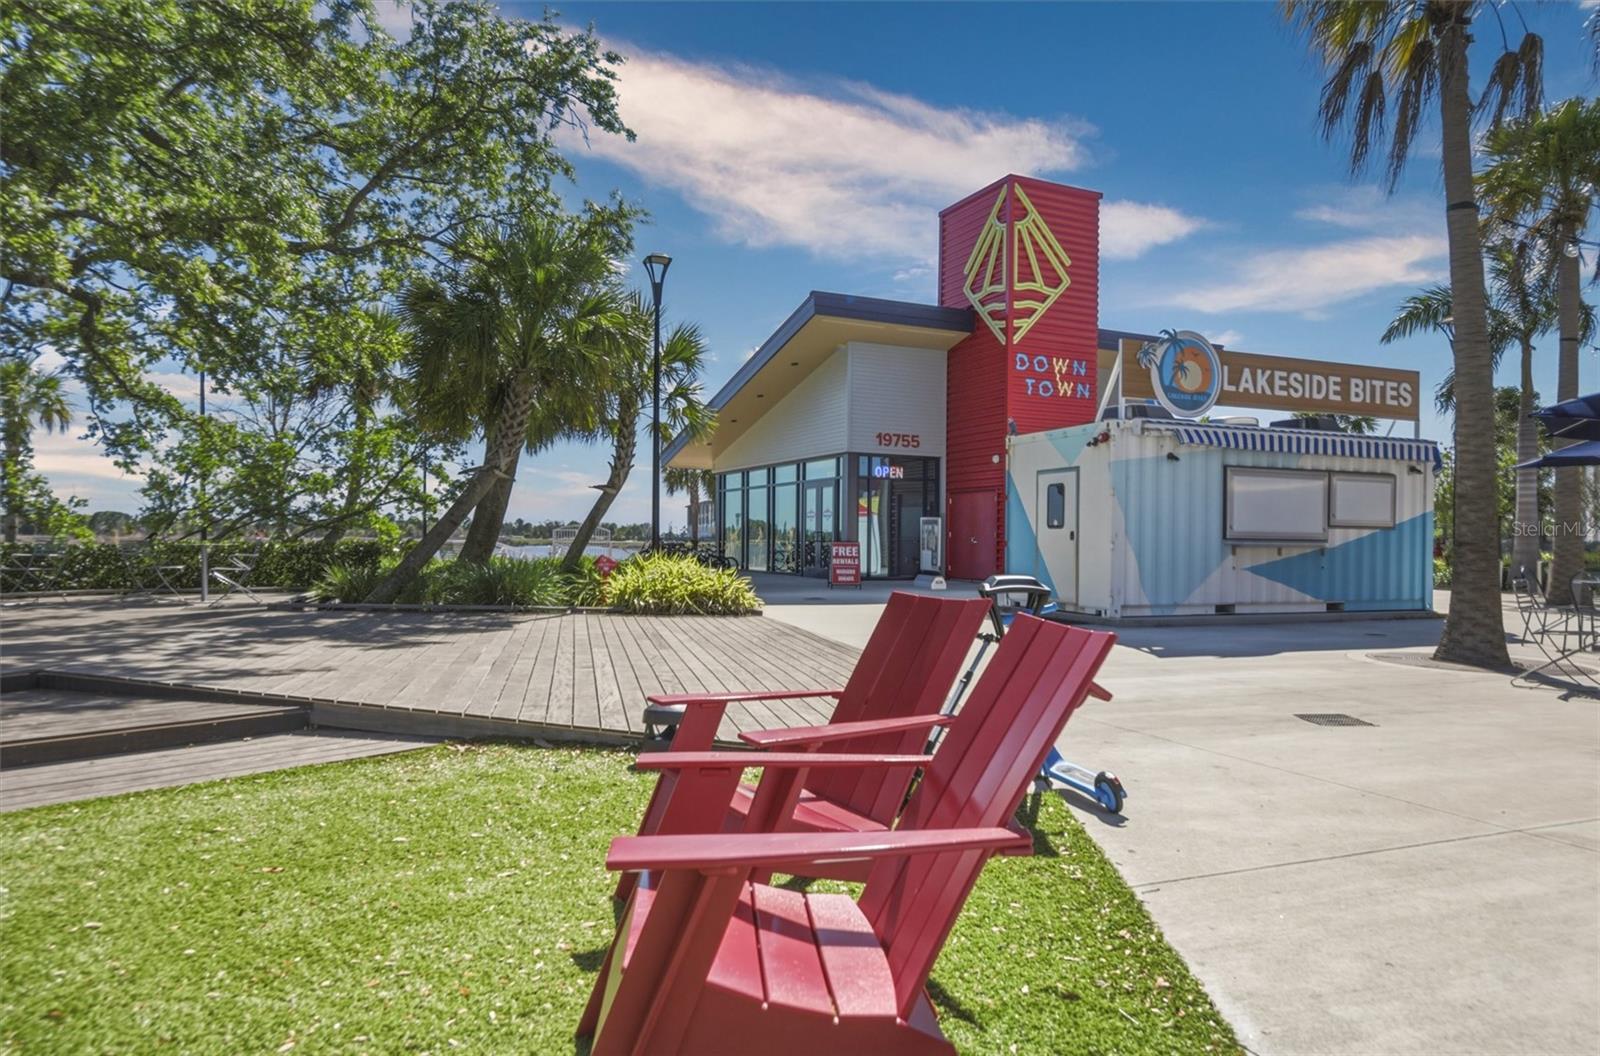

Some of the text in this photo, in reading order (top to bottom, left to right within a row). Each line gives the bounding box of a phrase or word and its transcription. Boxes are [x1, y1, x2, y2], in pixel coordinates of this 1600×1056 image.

[1015, 353, 1086, 376] DOWN
[1026, 378, 1090, 398] TOWN
[1222, 365, 1412, 407] LAKESIDE BITES
[876, 432, 920, 448] 19755
[875, 466, 903, 478] OPEN
[832, 546, 858, 557] FREE
